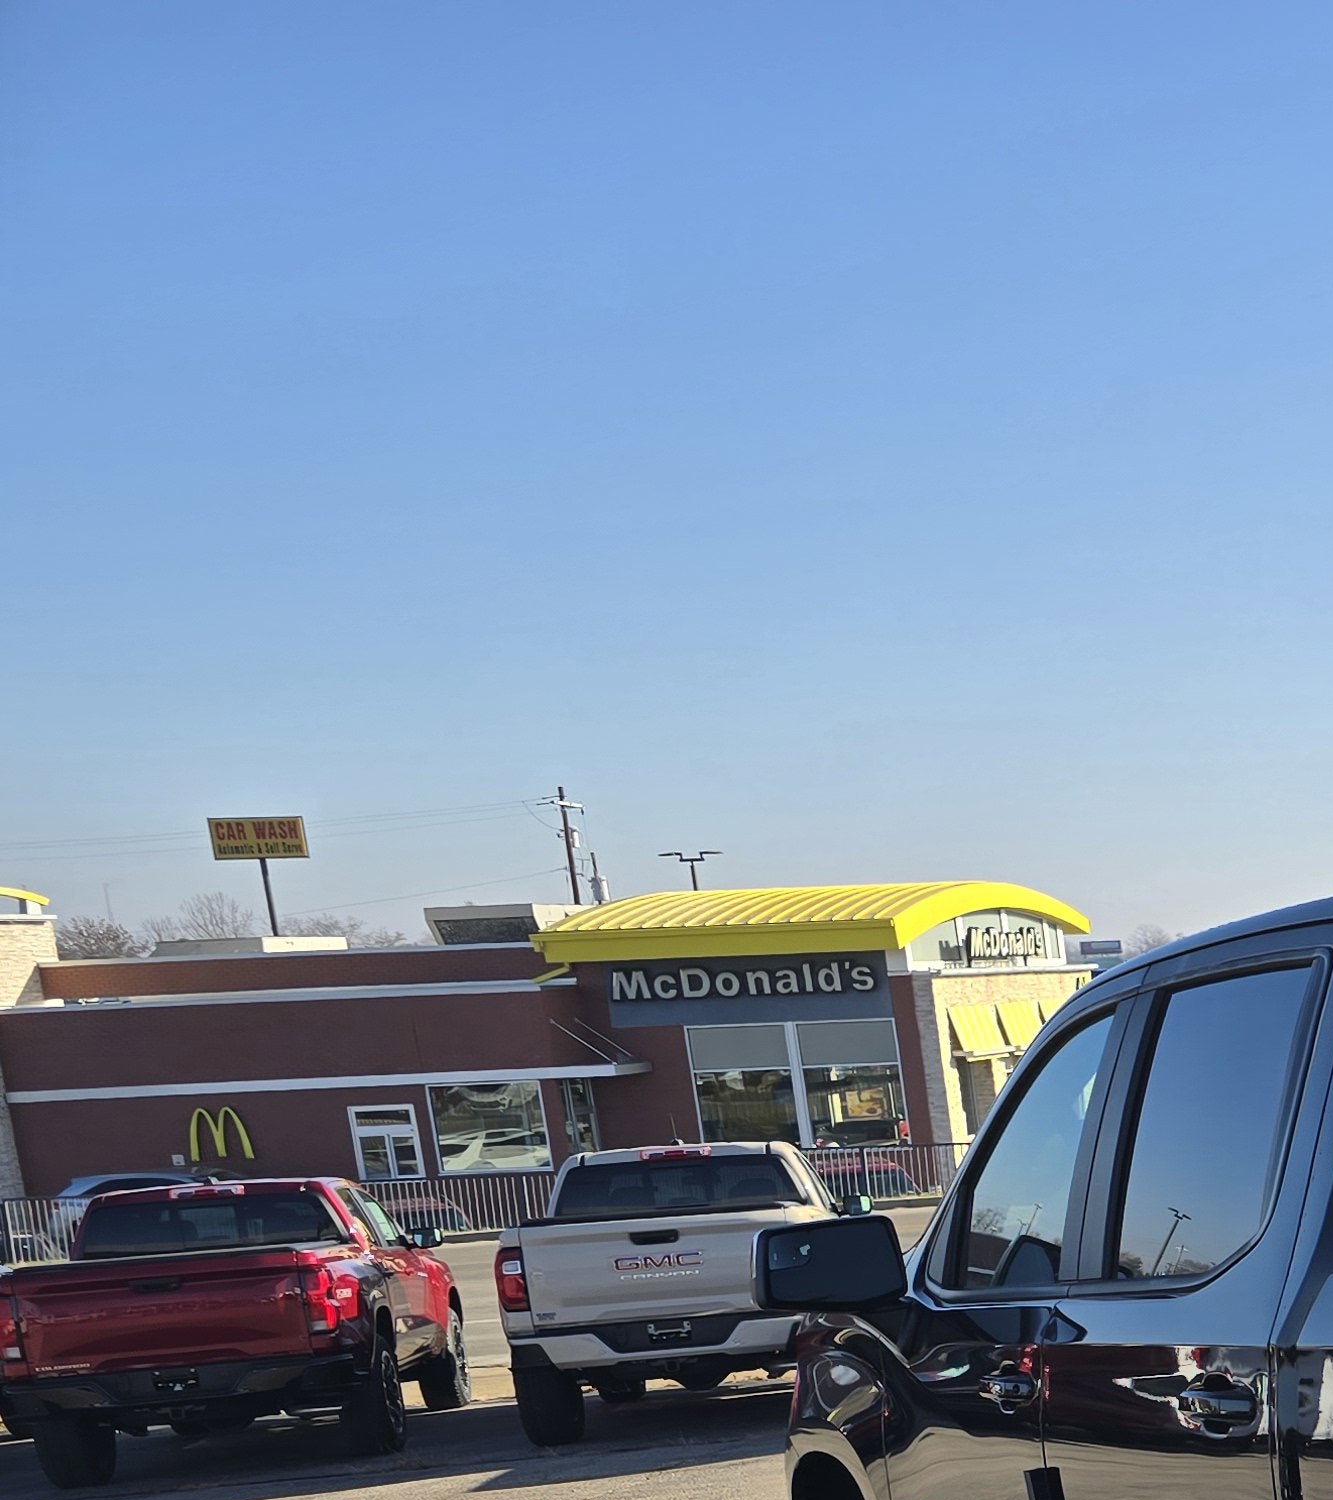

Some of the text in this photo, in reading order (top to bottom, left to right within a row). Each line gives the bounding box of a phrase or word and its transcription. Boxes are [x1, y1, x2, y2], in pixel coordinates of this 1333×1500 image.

[215, 820, 299, 841] CAR WASH
[970, 927, 1045, 957] McDonald's
[611, 961, 875, 1001] McDonald's
[614, 1251, 703, 1272] GMC
[620, 1269, 700, 1281] CANYON
